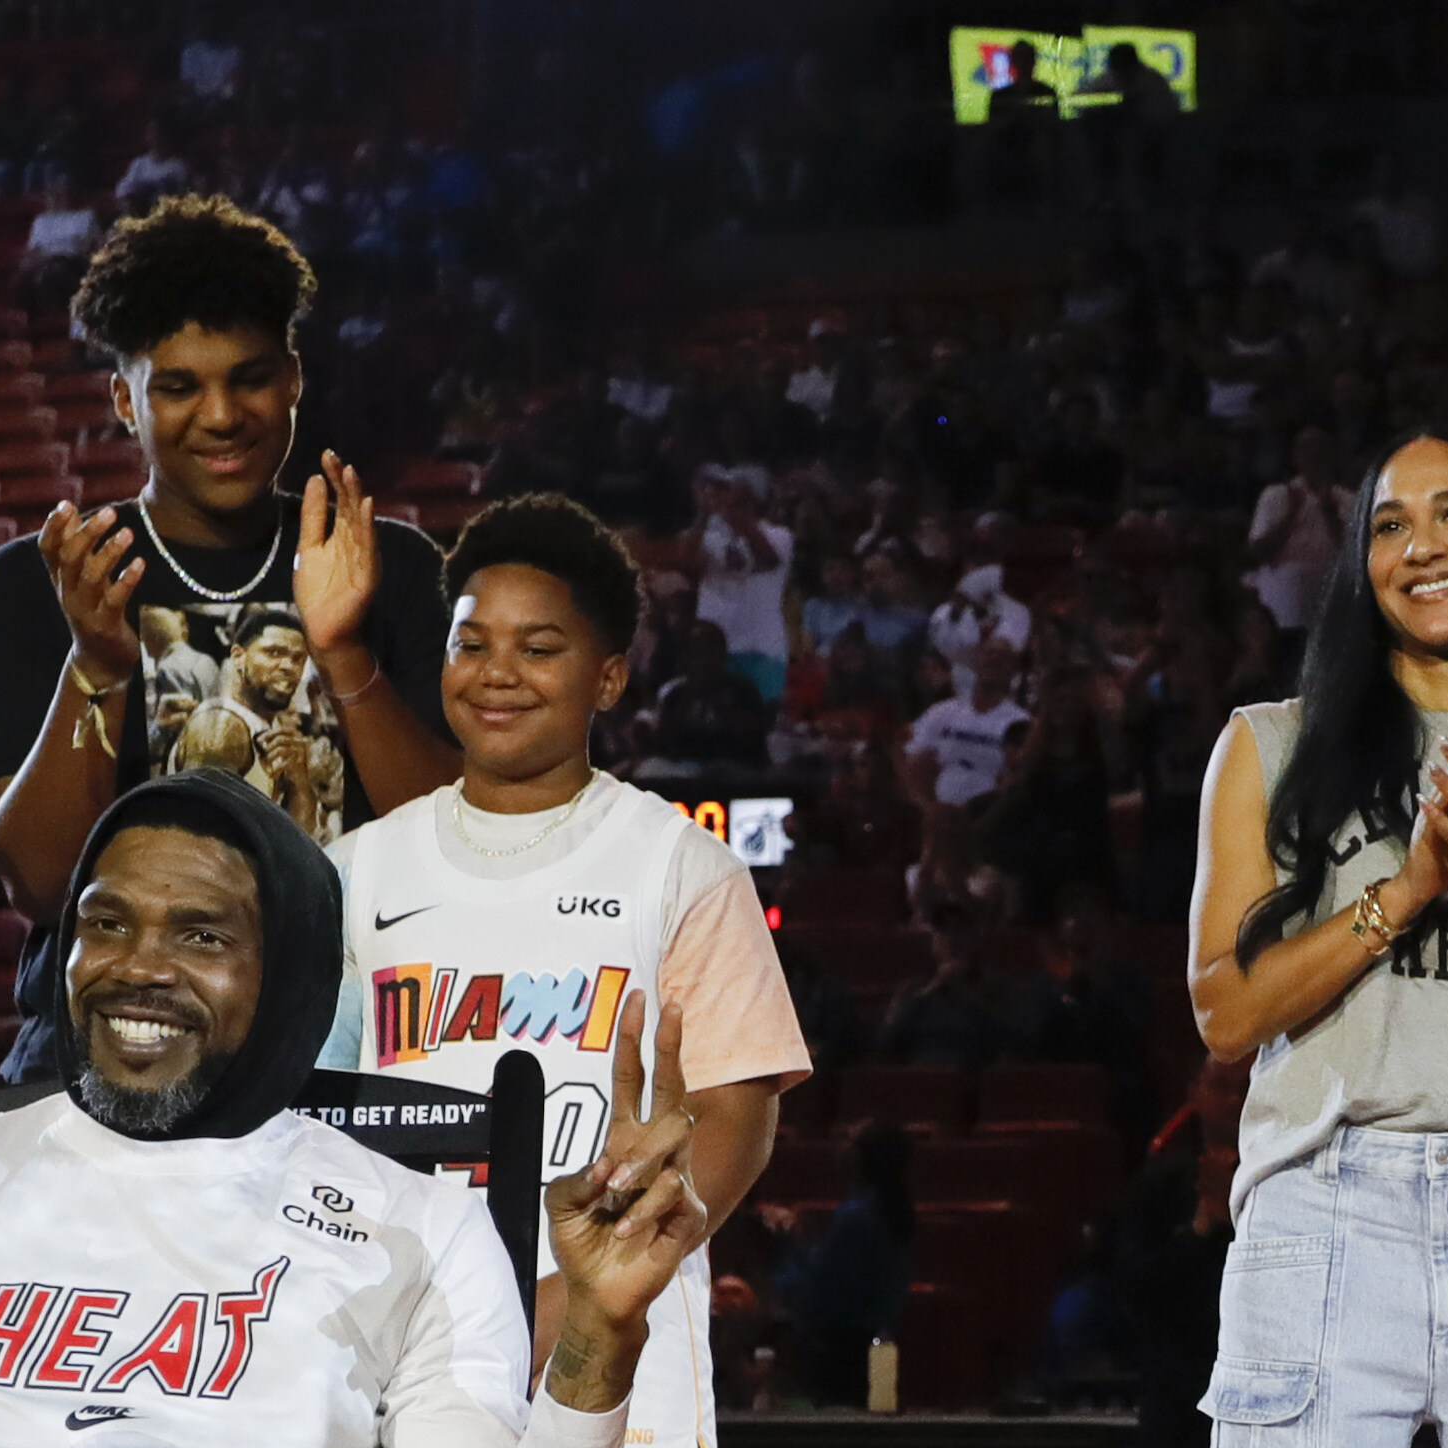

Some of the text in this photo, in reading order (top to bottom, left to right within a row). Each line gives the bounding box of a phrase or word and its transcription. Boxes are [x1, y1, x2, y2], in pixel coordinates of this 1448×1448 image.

[317, 1107, 347, 1127] TO
[352, 1106, 396, 1126] GET
[281, 1203, 369, 1244] Chain
[79, 1404, 136, 1417] NIKE
